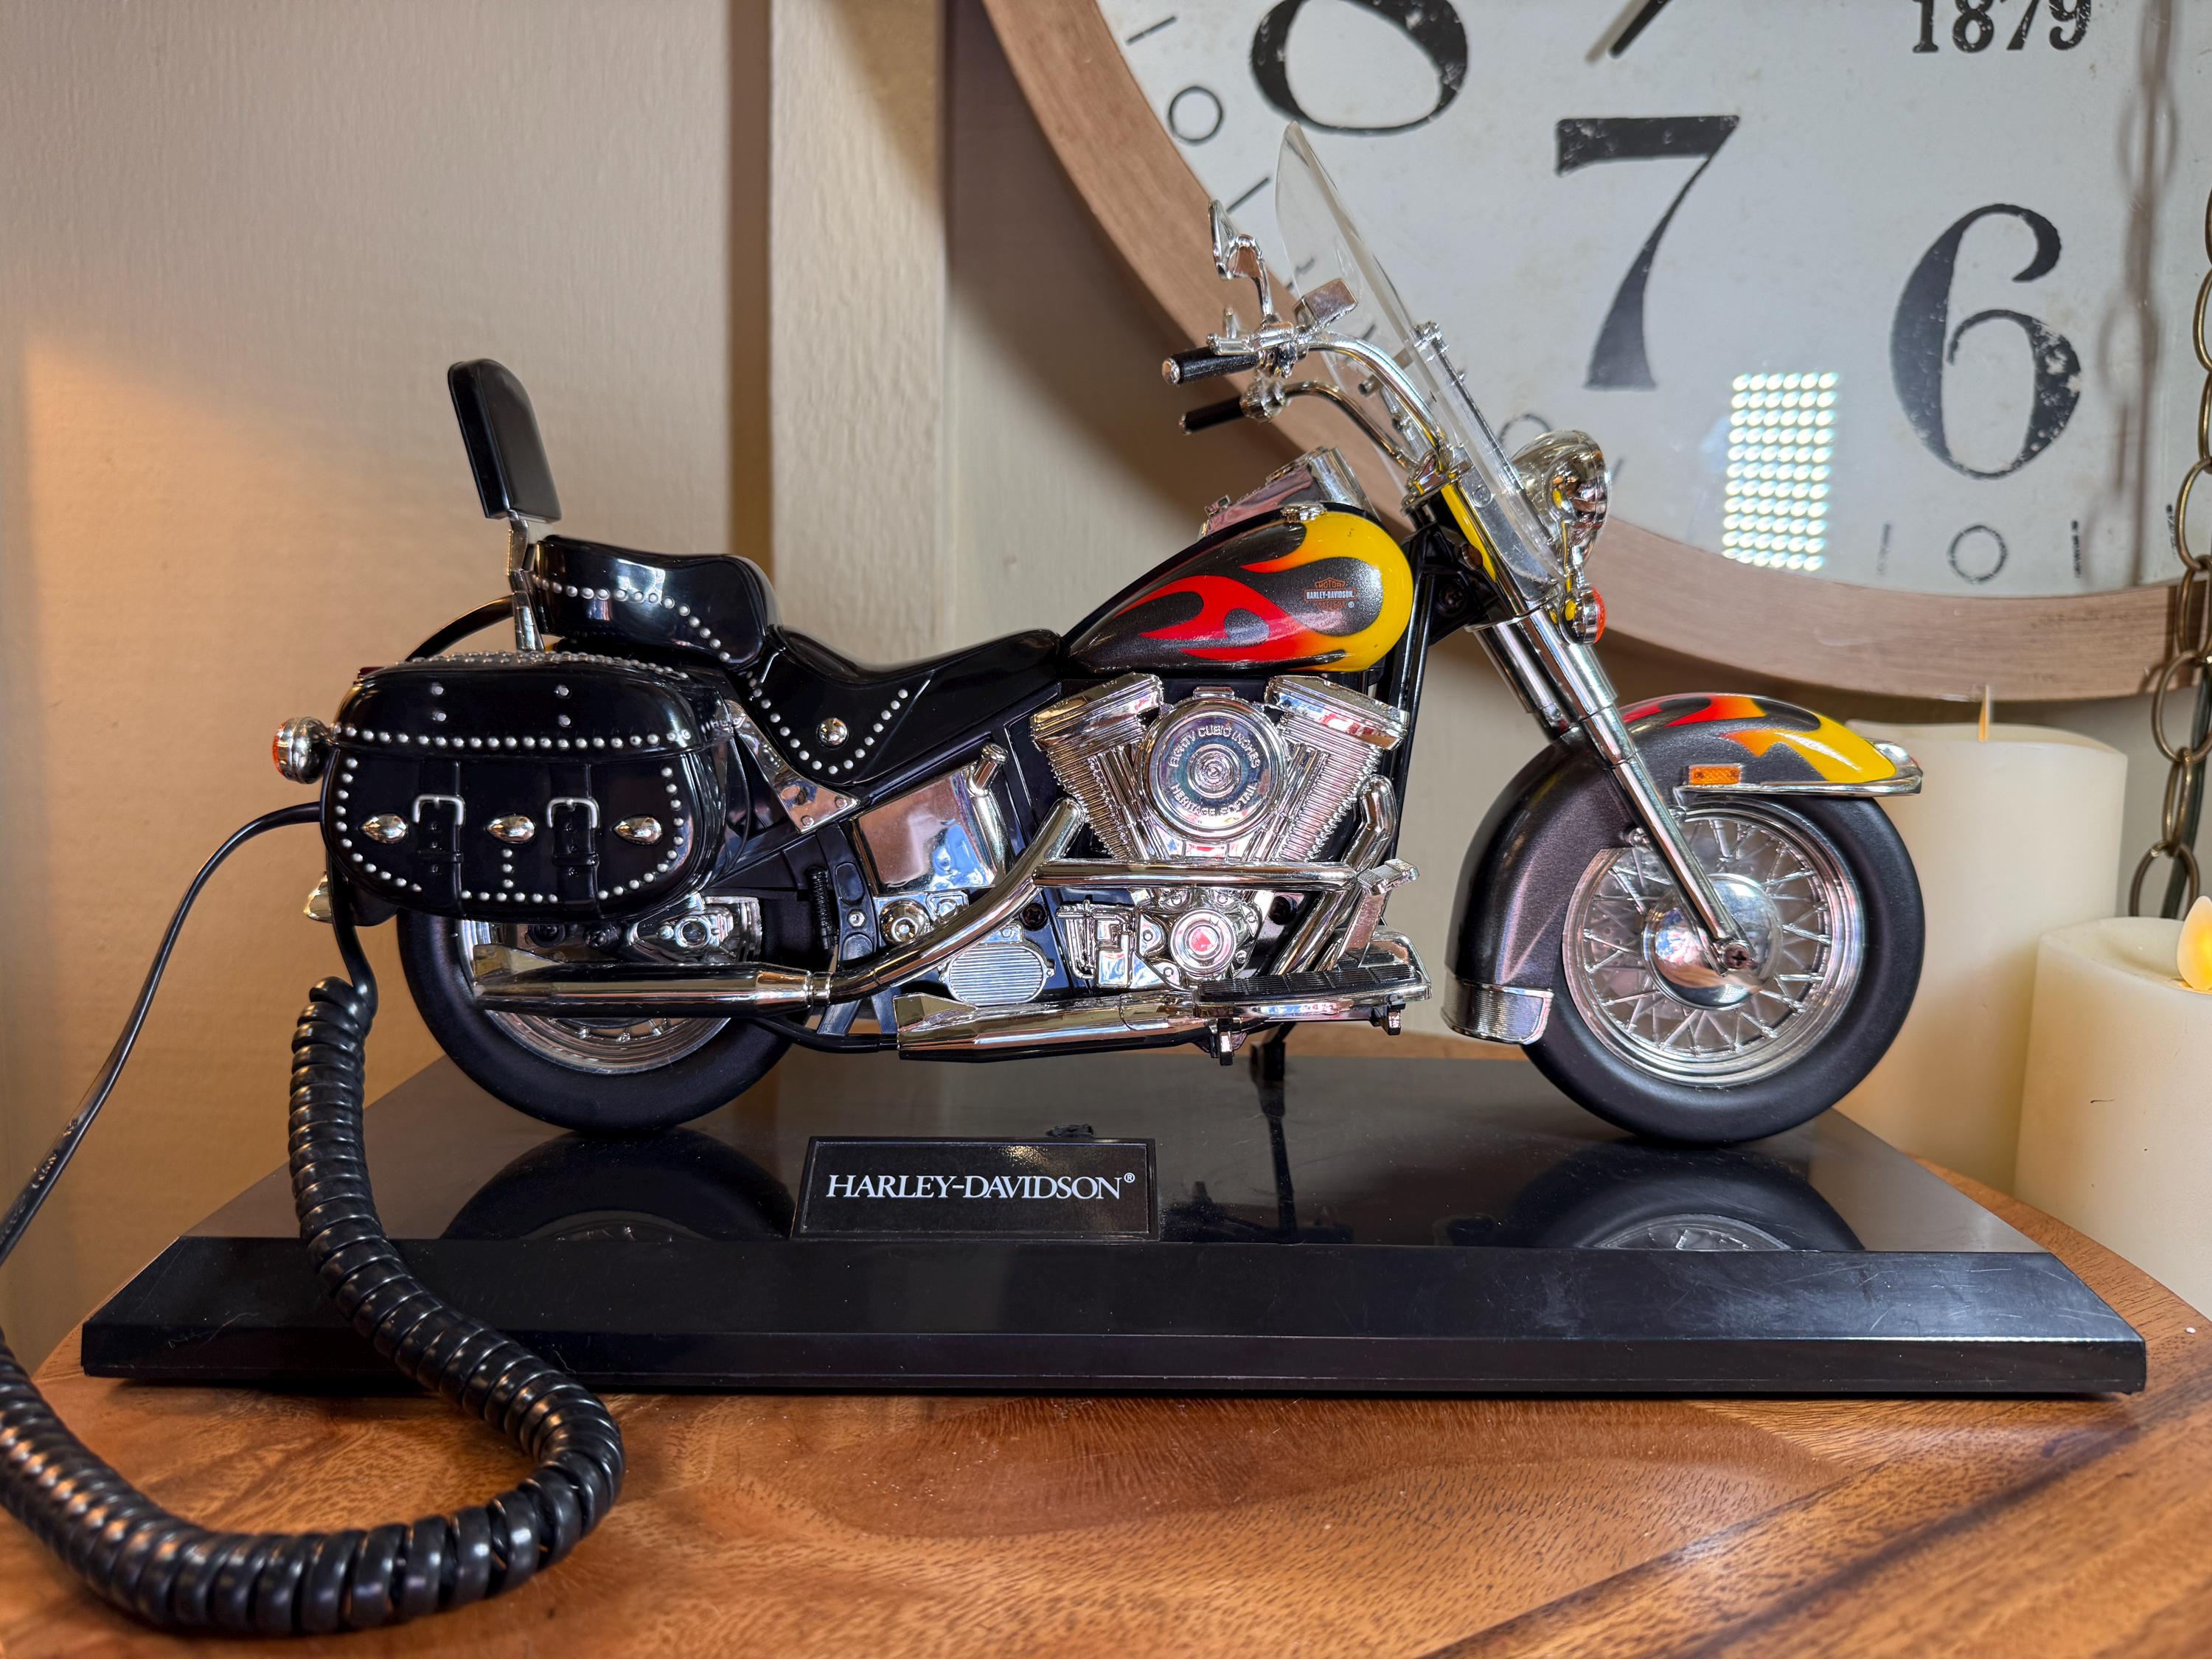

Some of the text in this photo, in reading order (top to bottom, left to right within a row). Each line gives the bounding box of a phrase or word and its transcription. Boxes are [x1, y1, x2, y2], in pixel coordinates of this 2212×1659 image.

[1913, 0, 2093, 53] 1879
[1554, 114, 1741, 392] 7
[1889, 202, 2082, 480] 6
[1318, 580, 1343, 589] MOTOR
[1168, 723, 1261, 769] EIGHTY CUBIC INCHES
[1169, 782, 1259, 817] HERITAGE SOFTAIL
